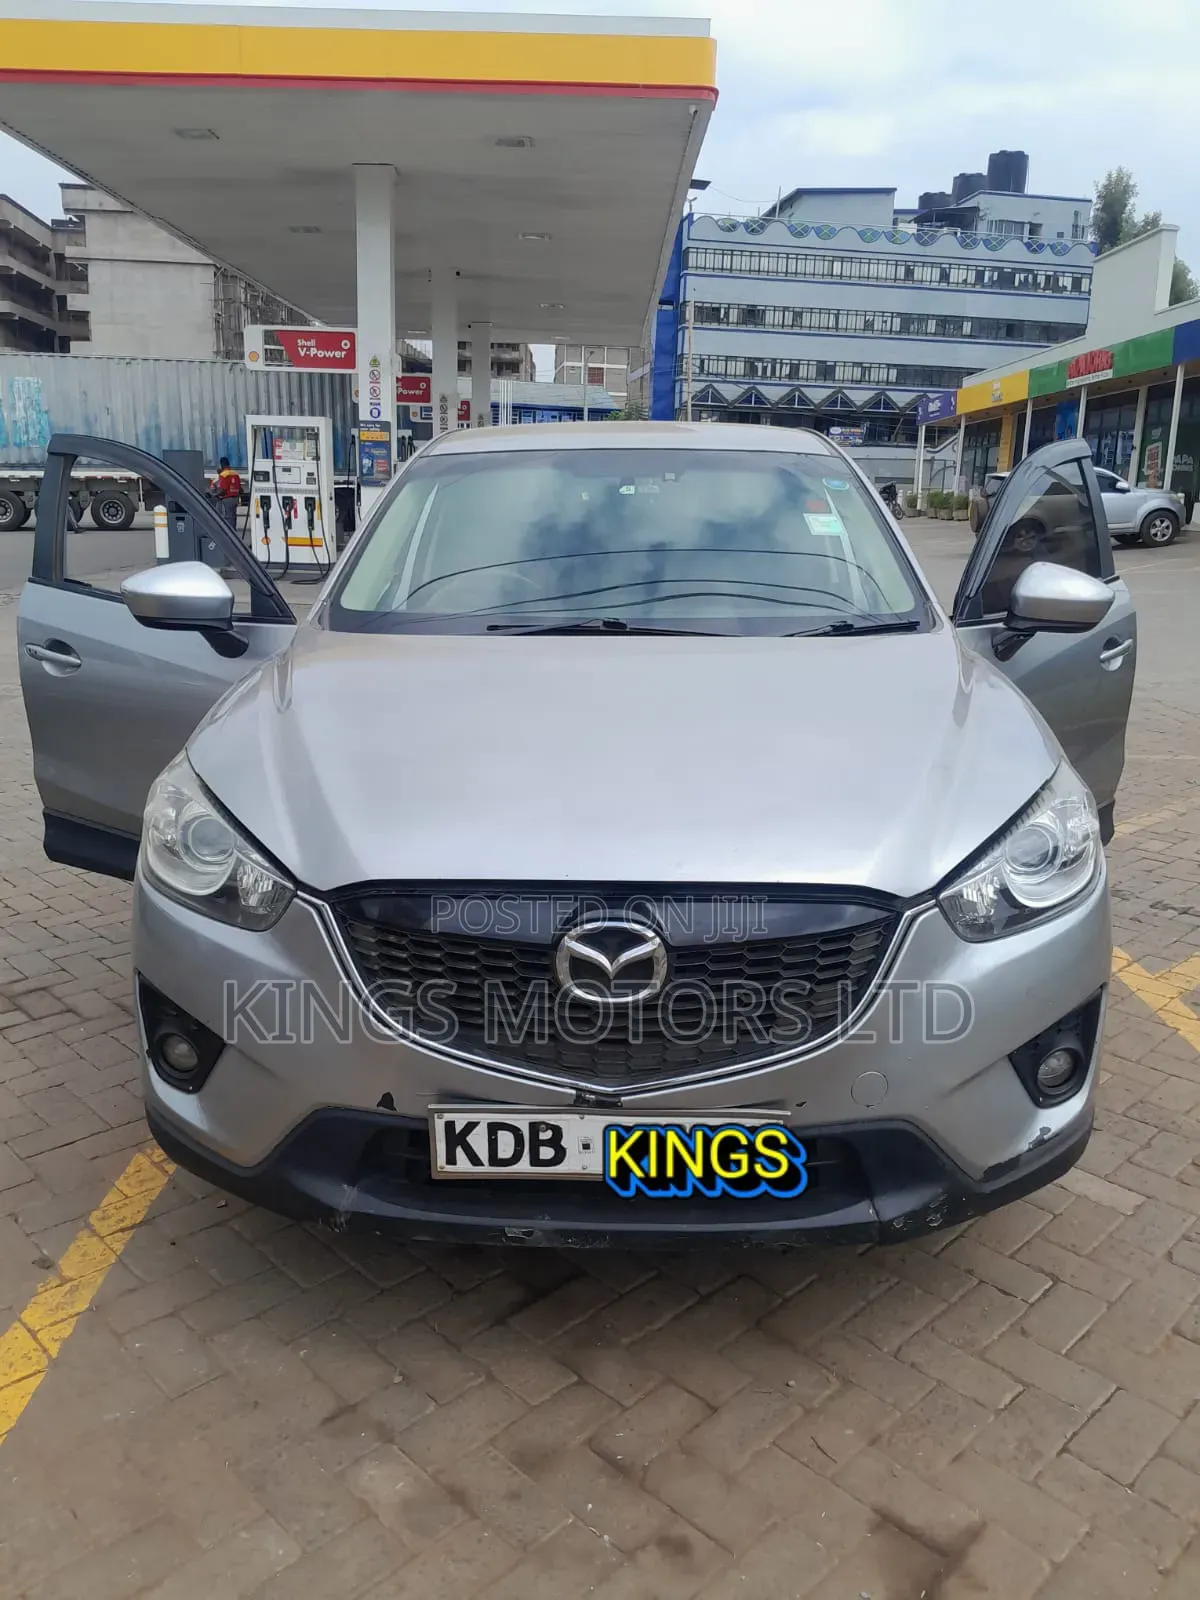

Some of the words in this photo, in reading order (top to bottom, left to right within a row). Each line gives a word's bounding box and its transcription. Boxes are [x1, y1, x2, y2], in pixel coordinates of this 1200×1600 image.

[297, 338, 316, 347] Shell
[298, 347, 347, 359] V-Power
[443, 1119, 567, 1167] KDB
